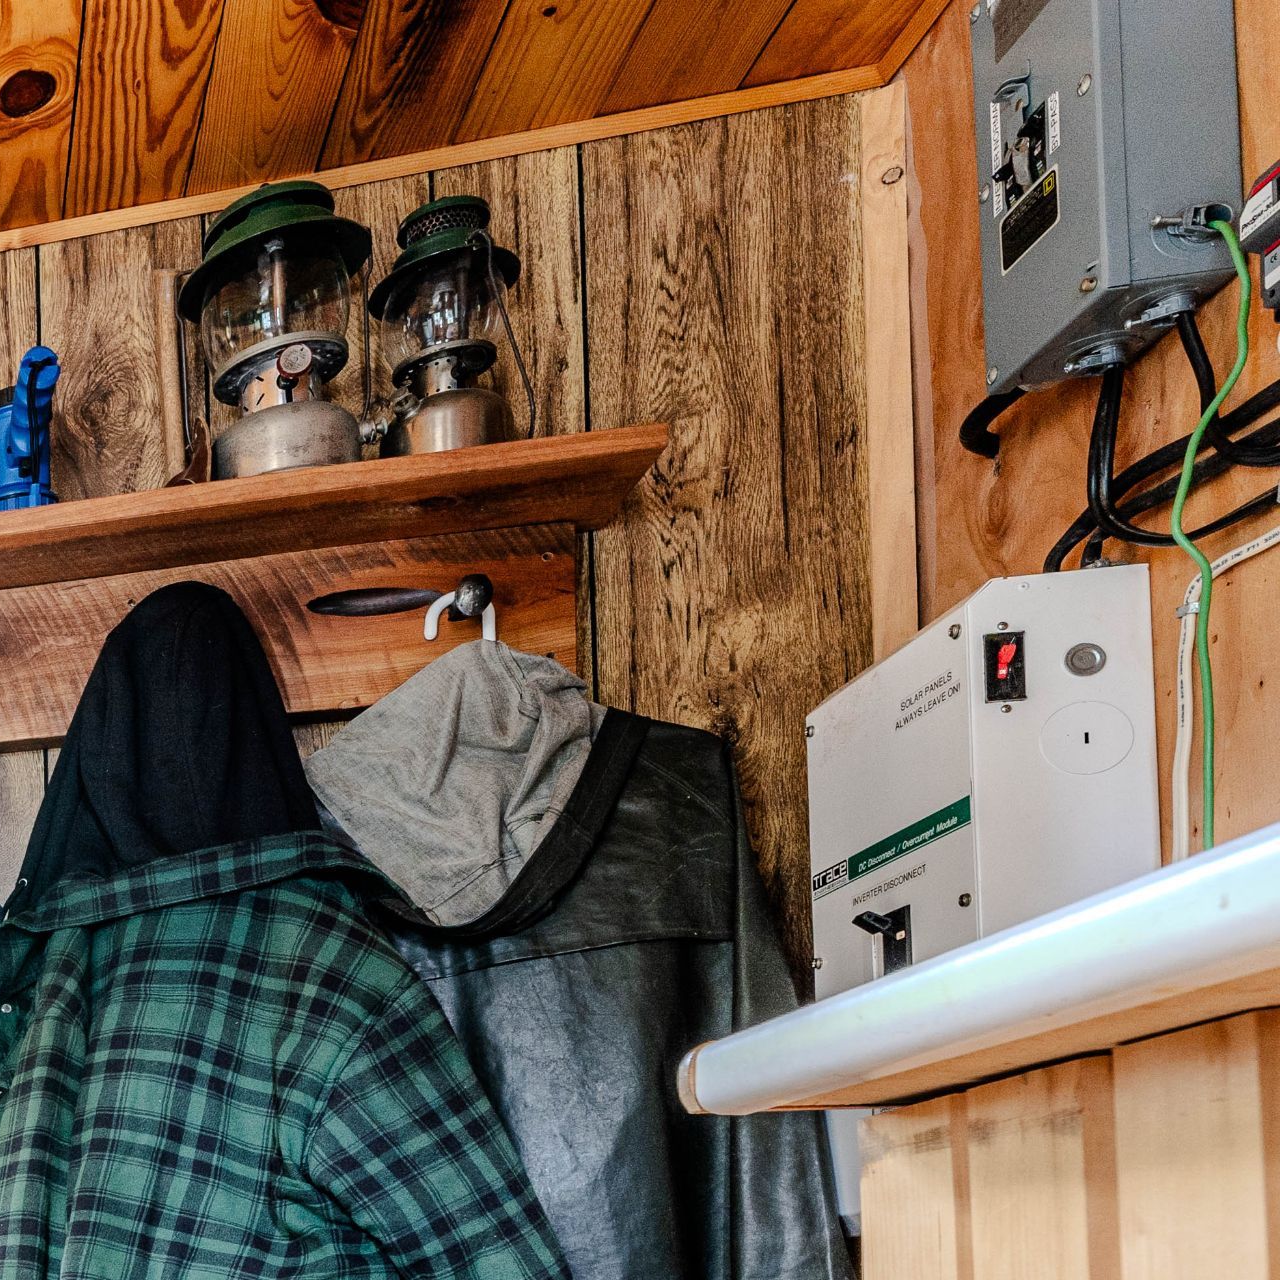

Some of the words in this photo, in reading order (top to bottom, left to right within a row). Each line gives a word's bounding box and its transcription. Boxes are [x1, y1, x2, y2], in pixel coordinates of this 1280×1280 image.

[1050, 92, 1060, 152] BY-PASS
[992, 154, 1003, 213] INVEER
[895, 706, 923, 732] ALWAYS
[923, 691, 947, 713] LEAVE
[900, 690, 924, 712] SOLAR
[924, 671, 953, 696] PANELS
[858, 862, 867, 873] DC
[867, 848, 896, 869] Disconnect
[935, 815, 958, 833] Module
[852, 885, 883, 907] INVERTER
[883, 863, 927, 892] DISCONNECT
